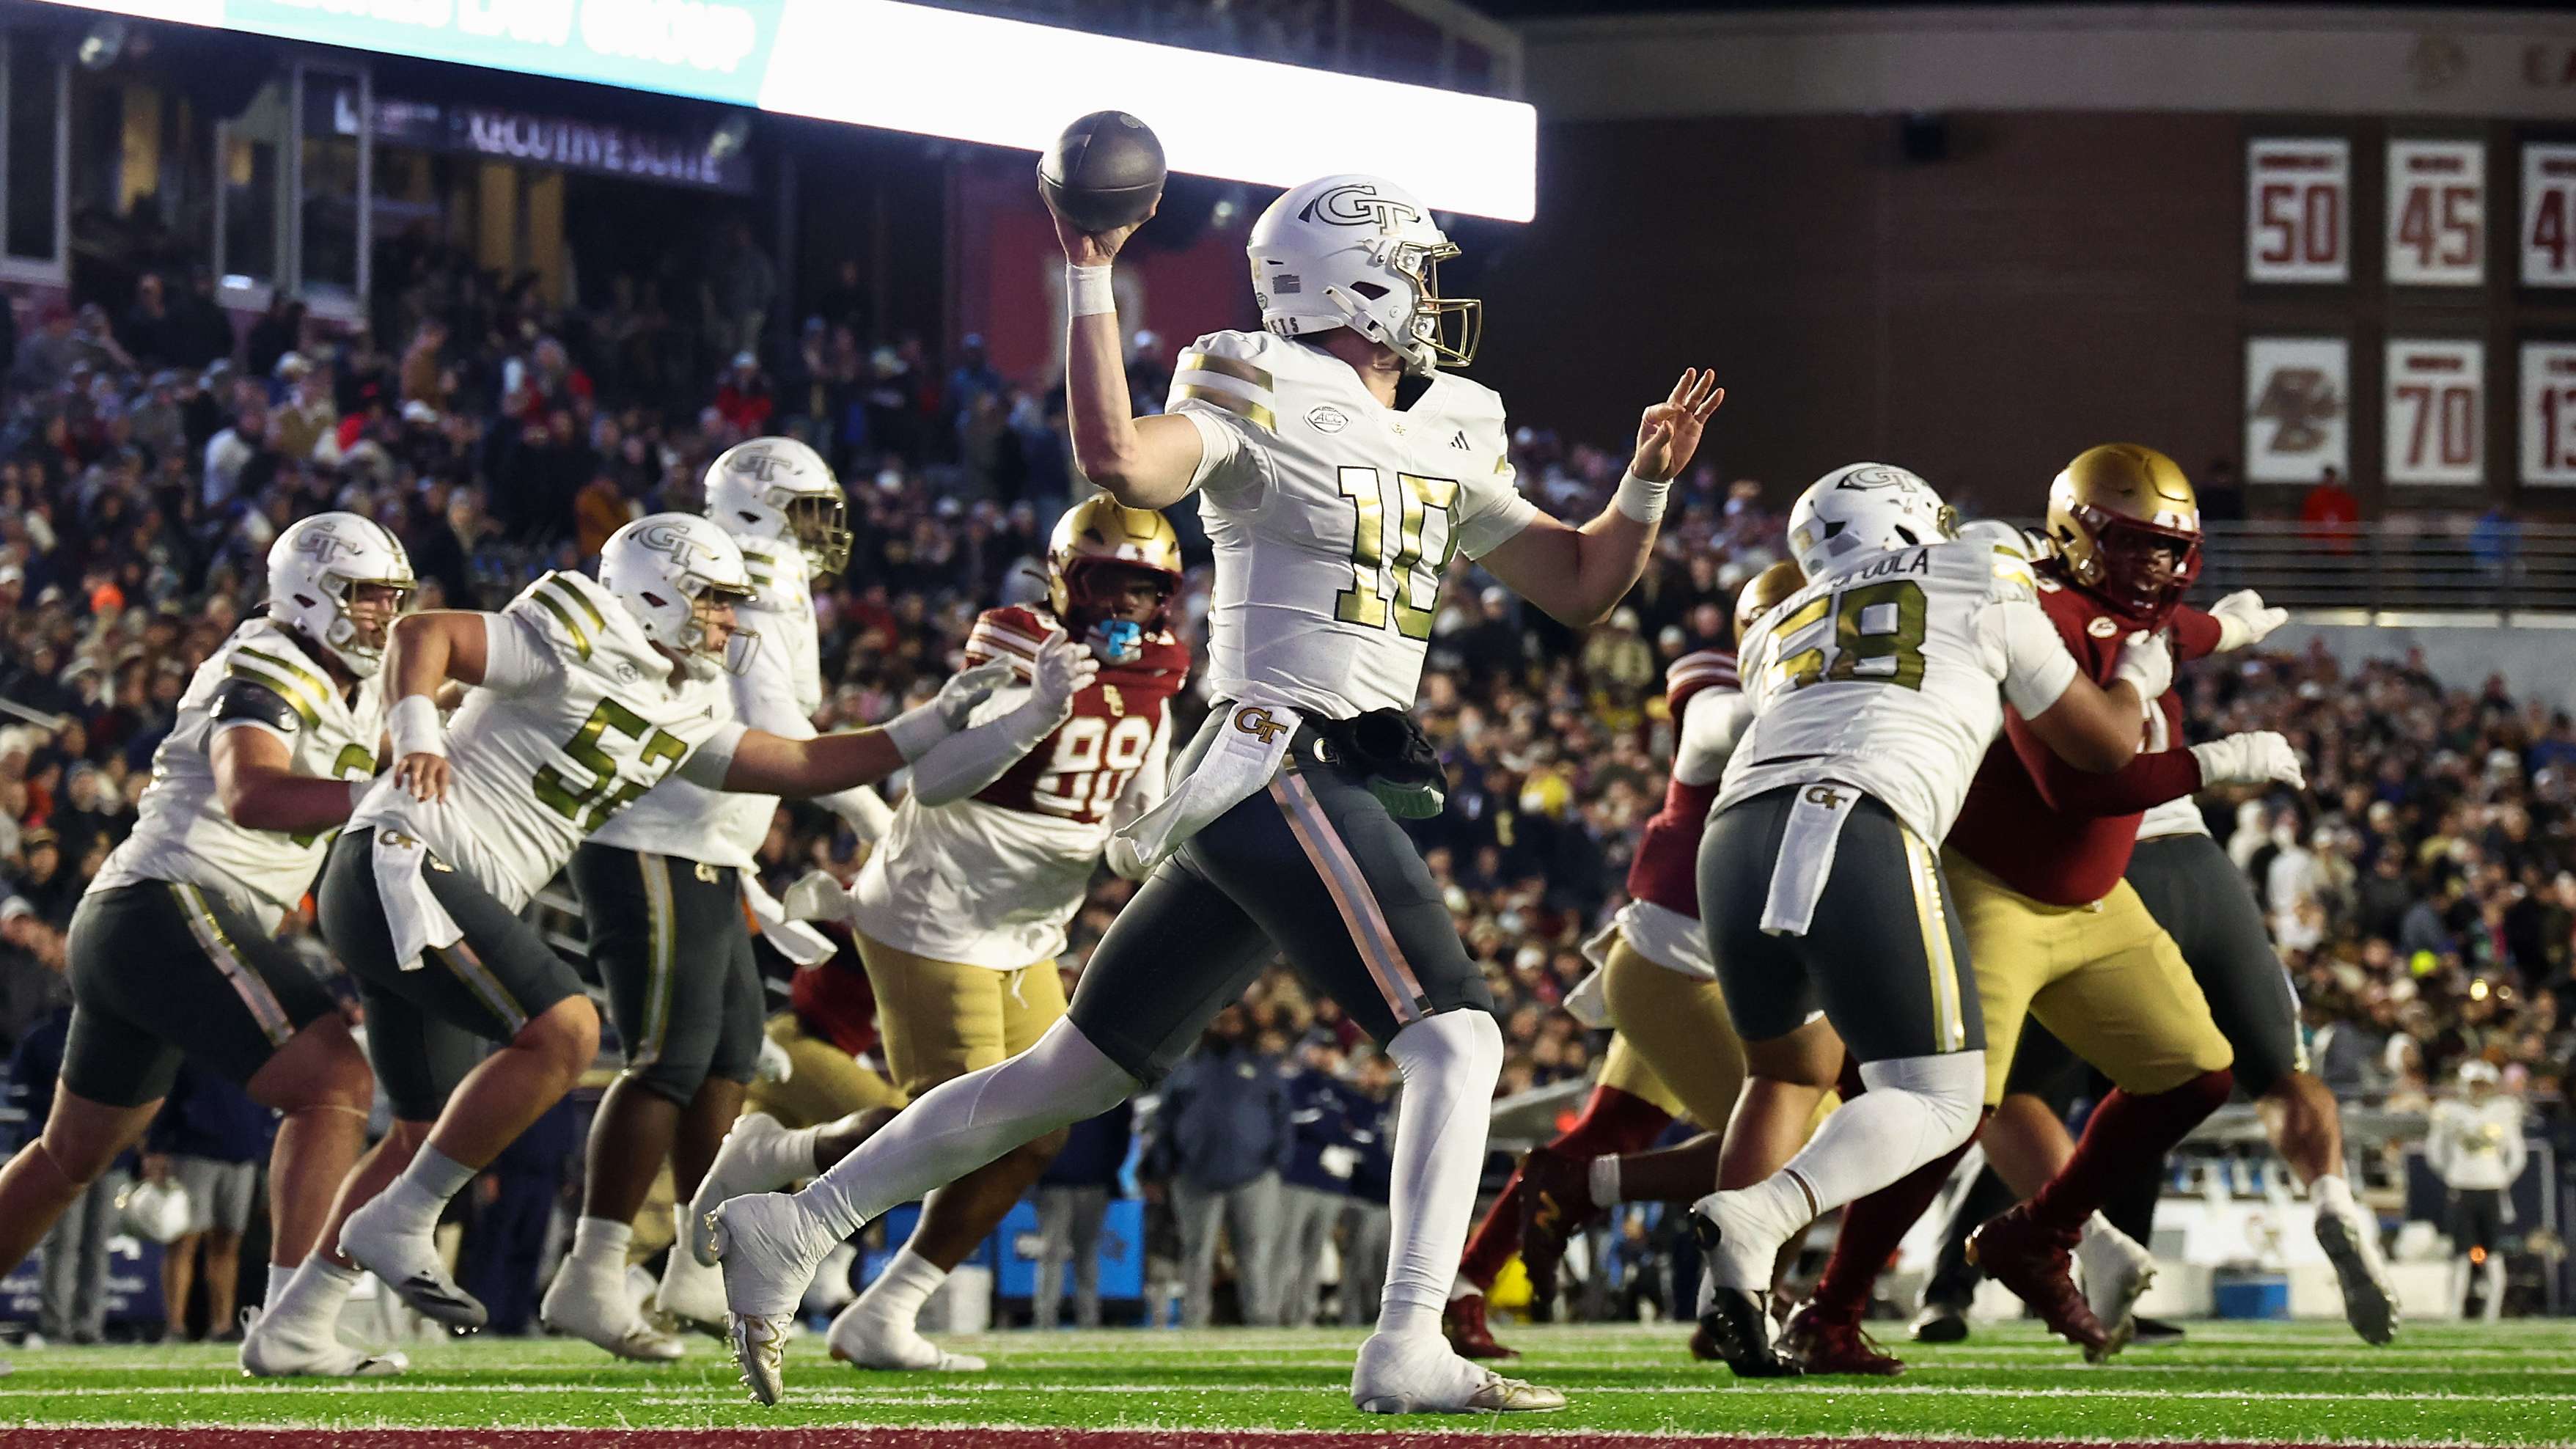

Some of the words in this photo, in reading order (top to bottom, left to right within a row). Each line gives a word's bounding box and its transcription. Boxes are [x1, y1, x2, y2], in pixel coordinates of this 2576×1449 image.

[1315, 184, 1421, 236] GT
[2261, 183, 2341, 264] 50
[2399, 186, 2483, 268] 45
[2533, 189, 2576, 271] 4
[2396, 386, 2473, 469] 70
[1335, 466, 1460, 642] 10
[1764, 579, 1928, 692] 58
[1234, 707, 1288, 744] GT
[1805, 785, 1849, 810] GT
